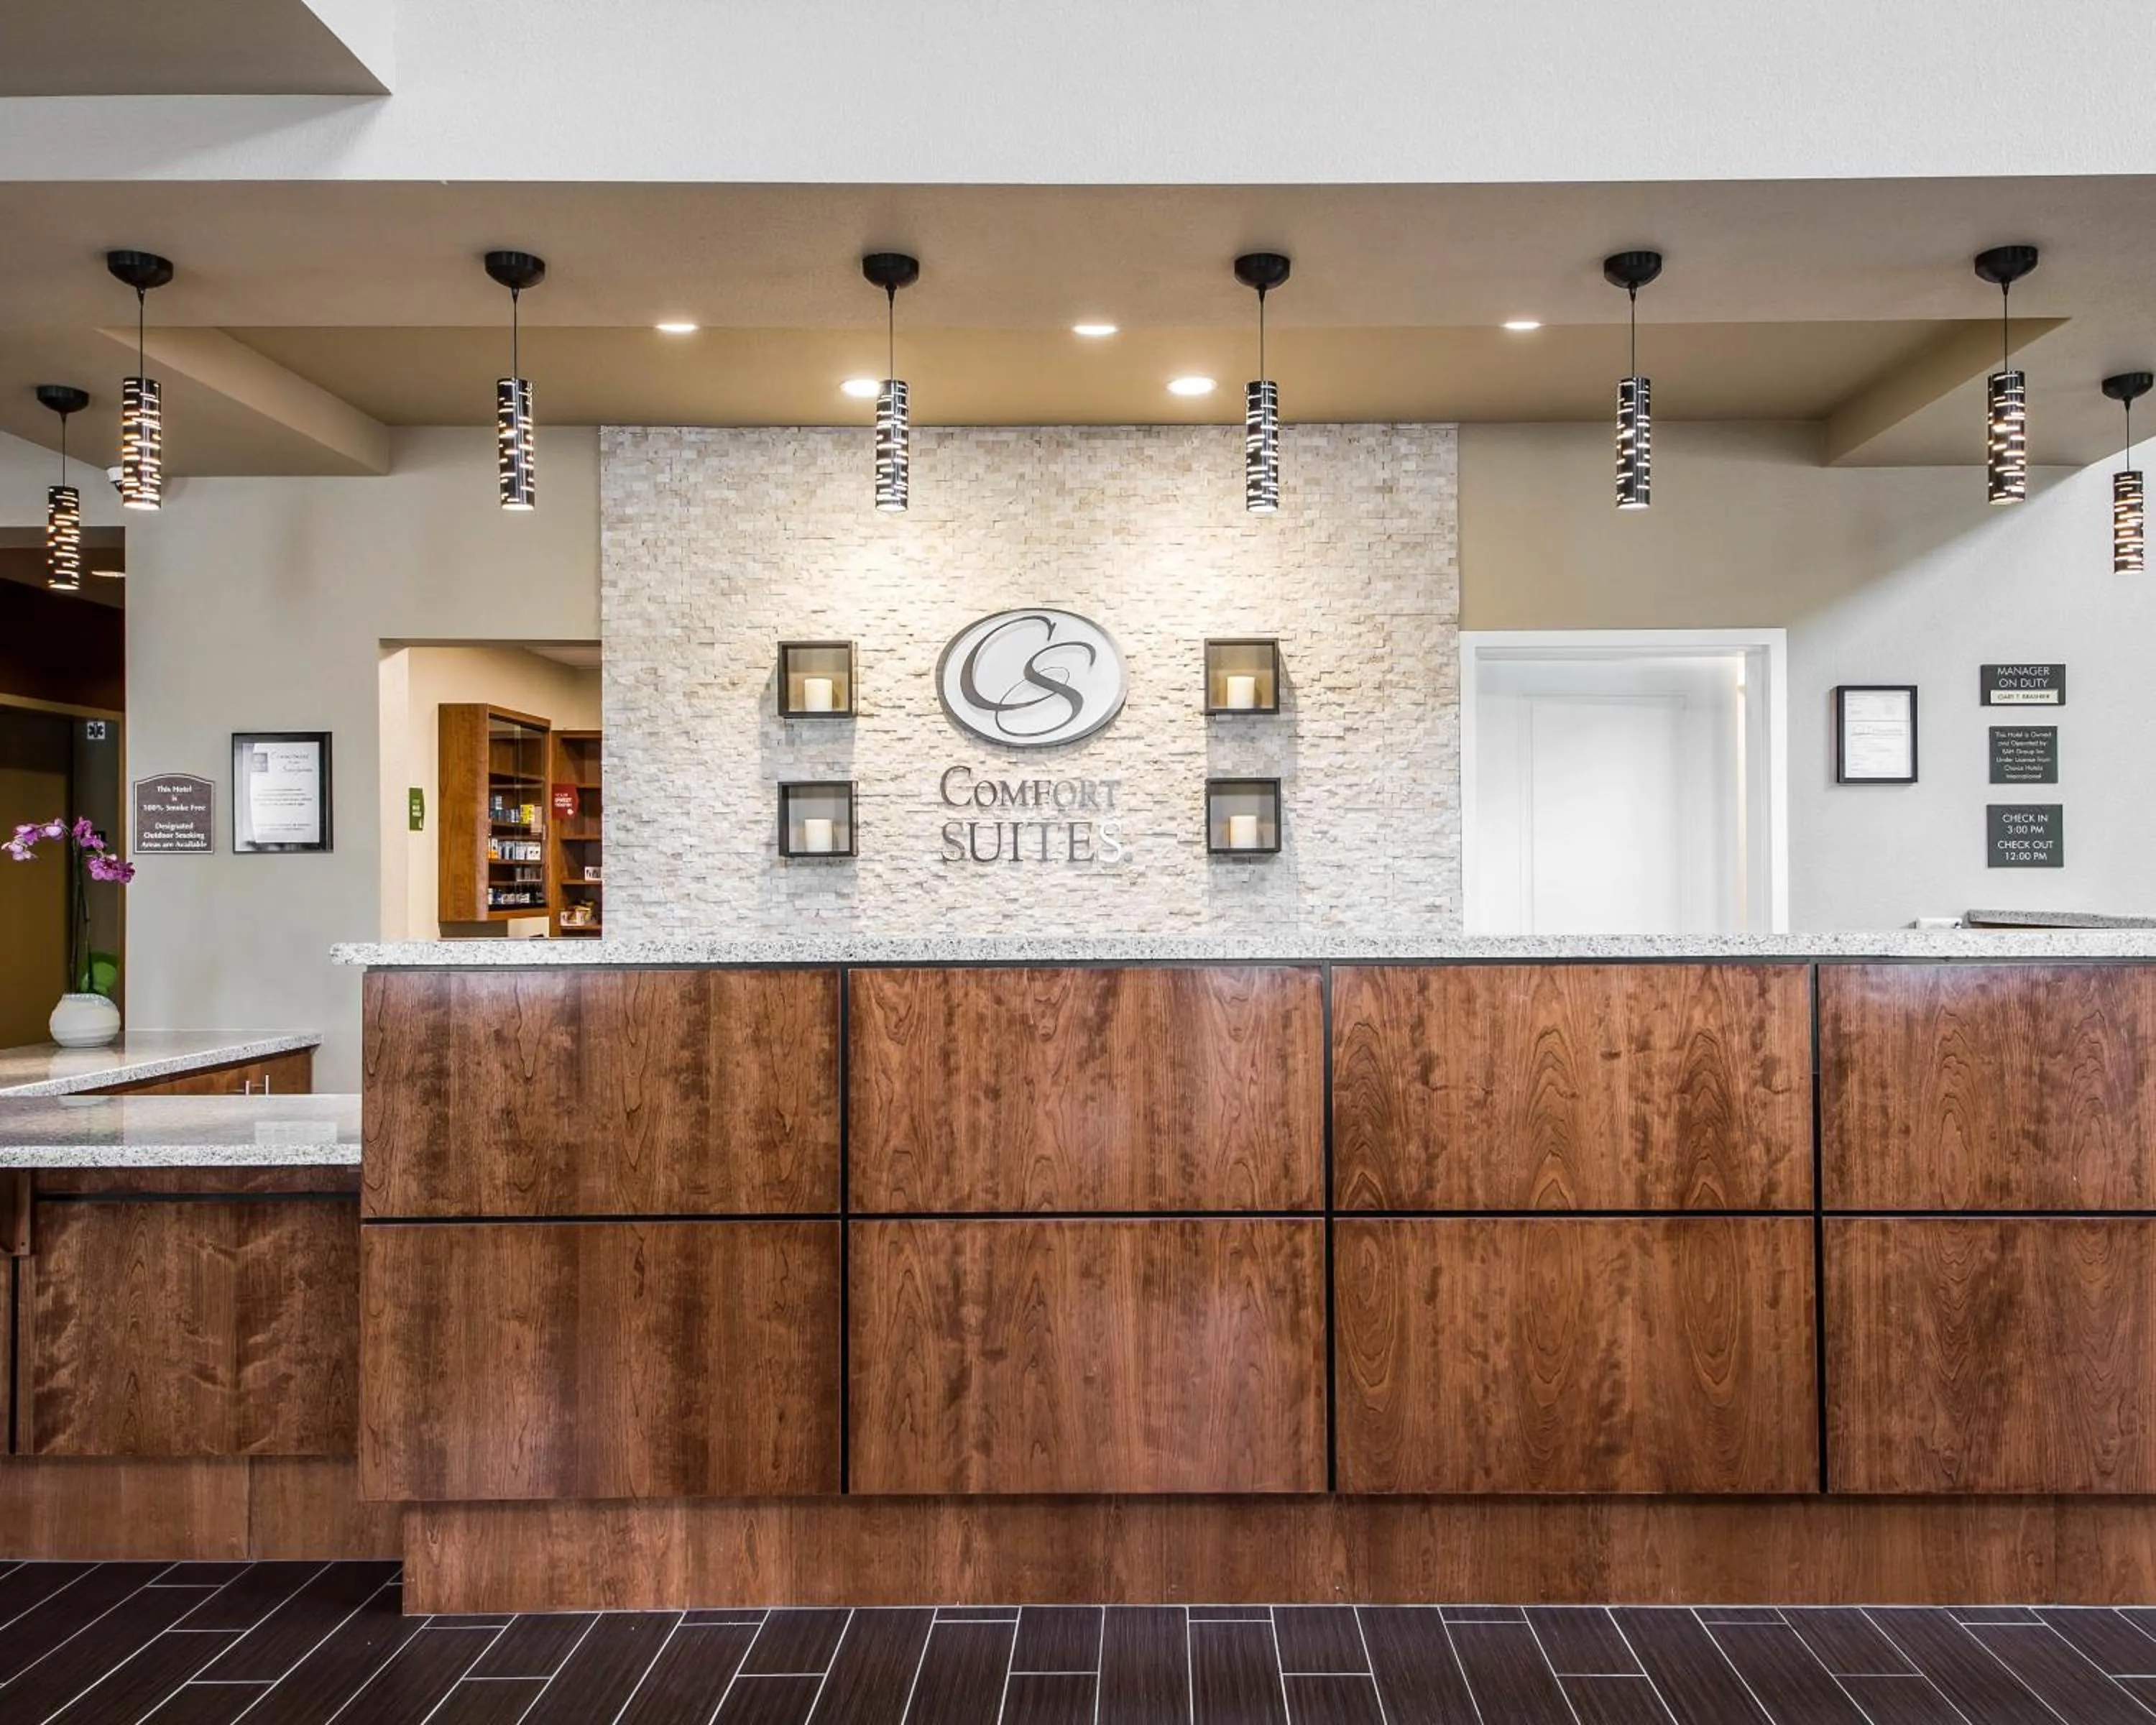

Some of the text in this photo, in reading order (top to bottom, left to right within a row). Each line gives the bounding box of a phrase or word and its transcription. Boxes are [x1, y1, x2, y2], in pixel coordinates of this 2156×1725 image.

[1997, 666, 2050, 676] MANAGER
[1999, 678, 2048, 688] ON DUTY
[2001, 814, 2048, 823] CHECK IN
[155, 822, 193, 831] Designated
[2007, 824, 2045, 834] 3:00 PM
[940, 820, 1123, 865] SUITES
[1997, 840, 2054, 849] CHECK OUT
[2005, 852, 2047, 860] 12:00 PM
